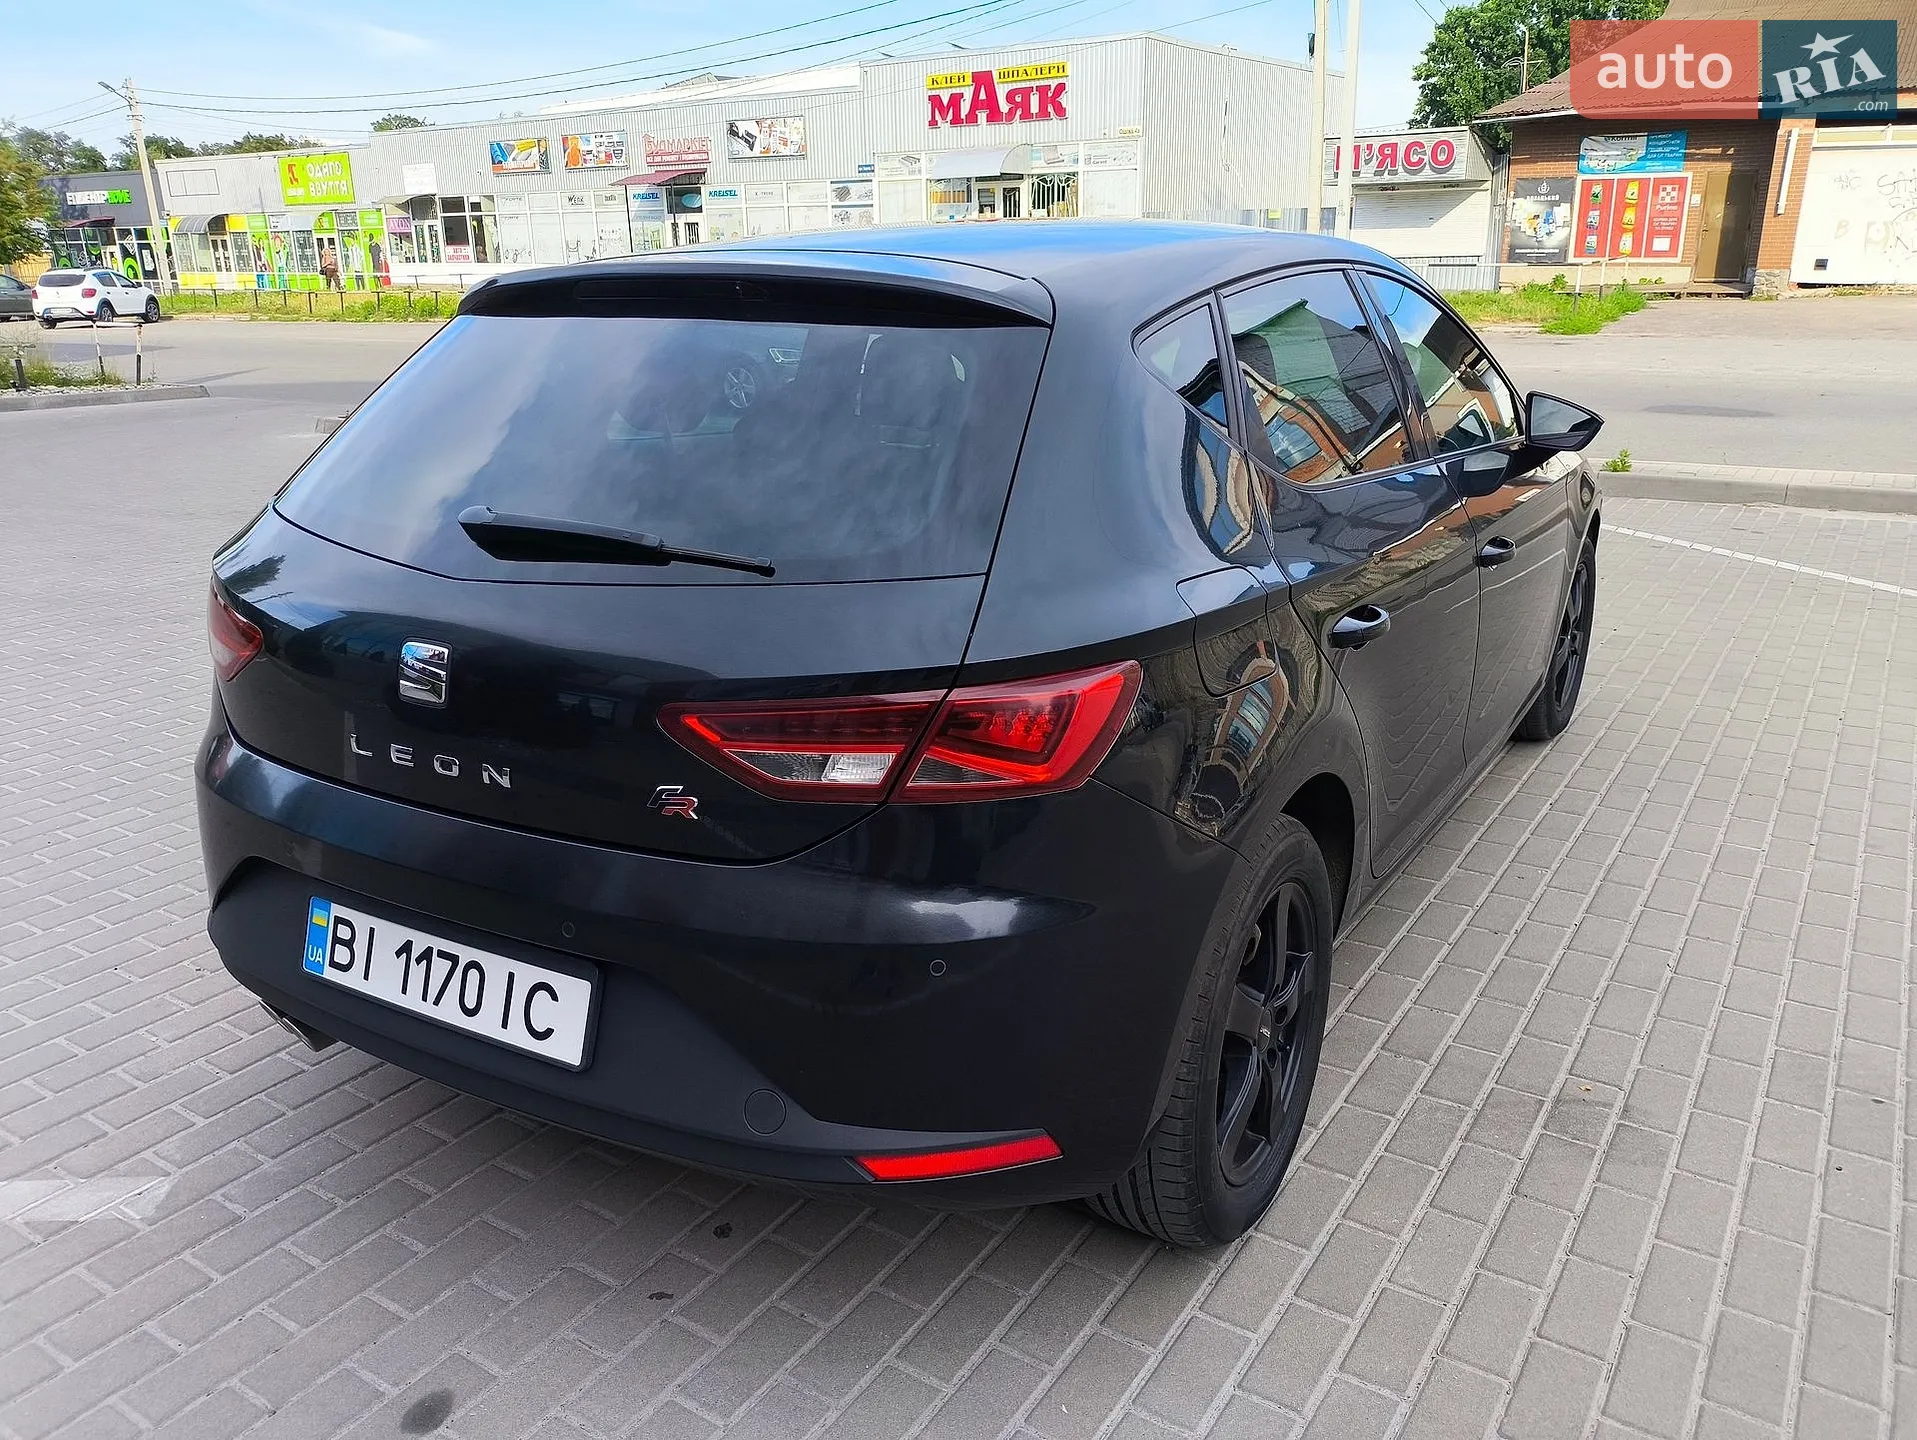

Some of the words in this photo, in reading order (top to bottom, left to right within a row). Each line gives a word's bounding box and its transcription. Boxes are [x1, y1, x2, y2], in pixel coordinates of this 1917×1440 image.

[931, 74, 966, 86] КЛЕЙ
[998, 64, 1066, 80] ШПАЛЕРИ
[927, 69, 1068, 128] МАЯК
[633, 192, 660, 200] KREISEL
[708, 189, 738, 198] KREISEL
[388, 218, 411, 230] AVON
[349, 733, 512, 789] LEON
[646, 785, 699, 821] FR
[307, 946, 323, 964] UA
[328, 914, 376, 983] BI
[394, 938, 487, 1018] 1170
[501, 971, 560, 1042] IC
